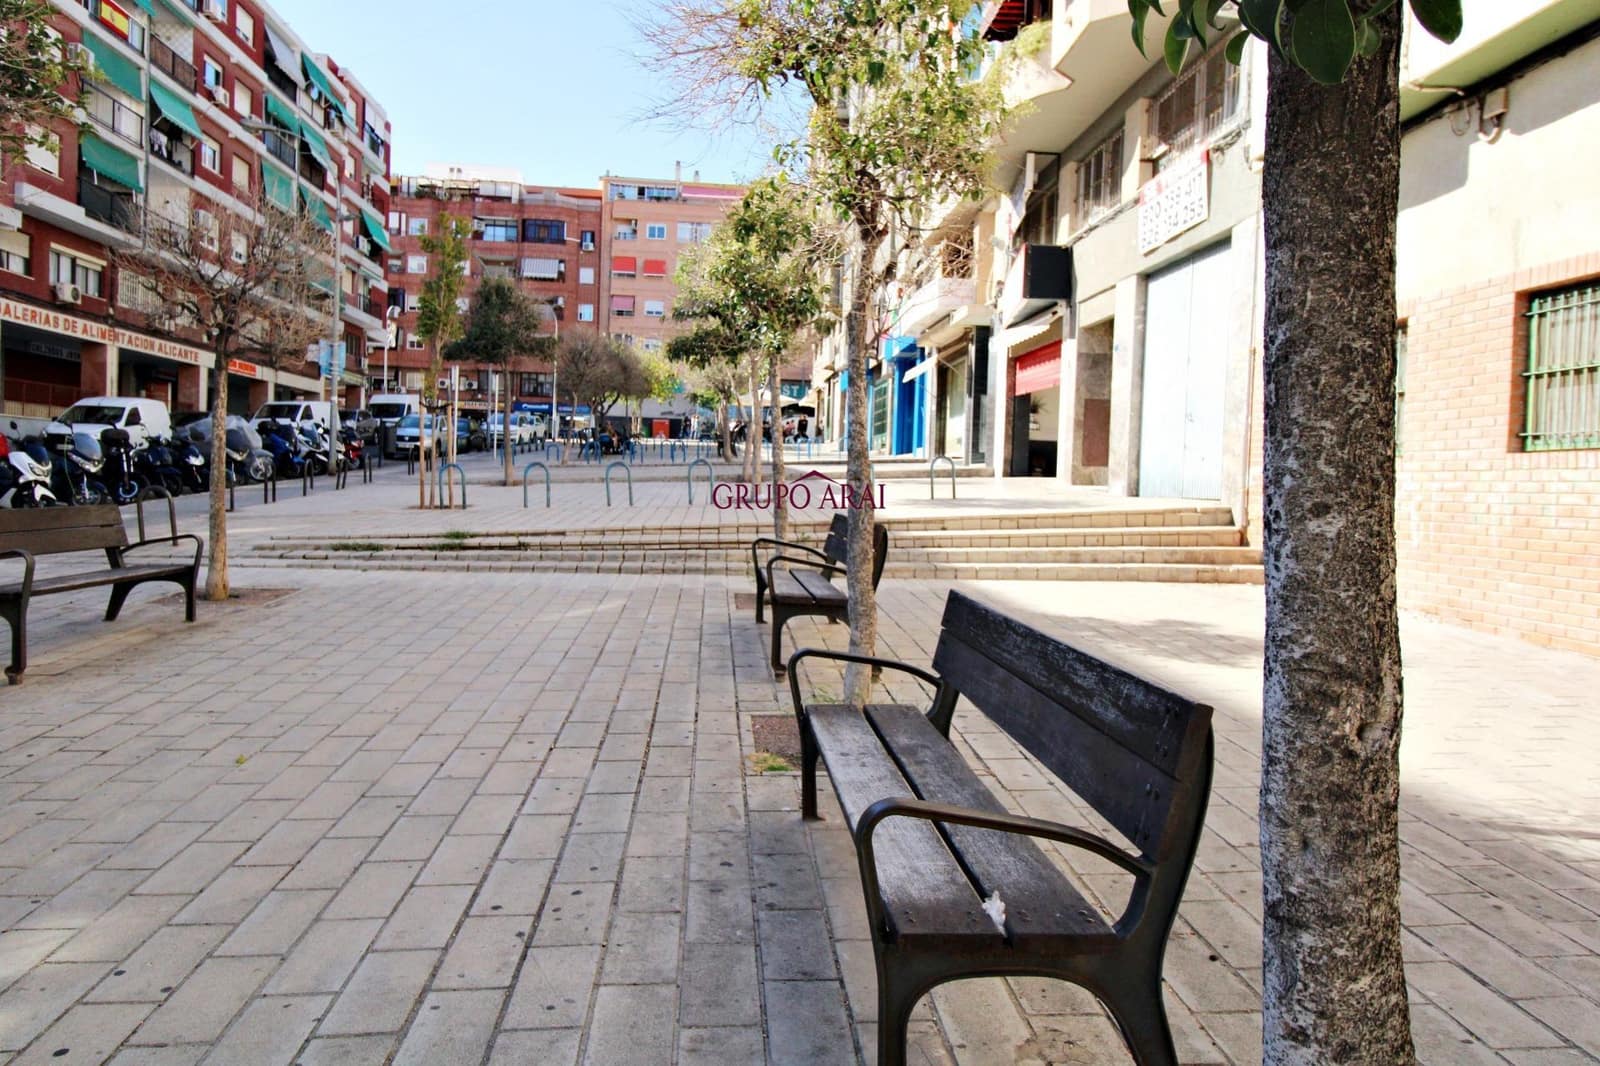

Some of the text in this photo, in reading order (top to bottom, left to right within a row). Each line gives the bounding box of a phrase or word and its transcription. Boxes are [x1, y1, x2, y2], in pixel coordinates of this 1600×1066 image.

[63, 317, 78, 333] DE
[81, 323, 155, 351] ALIMENTACION
[157, 343, 200, 362] ALICANTE
